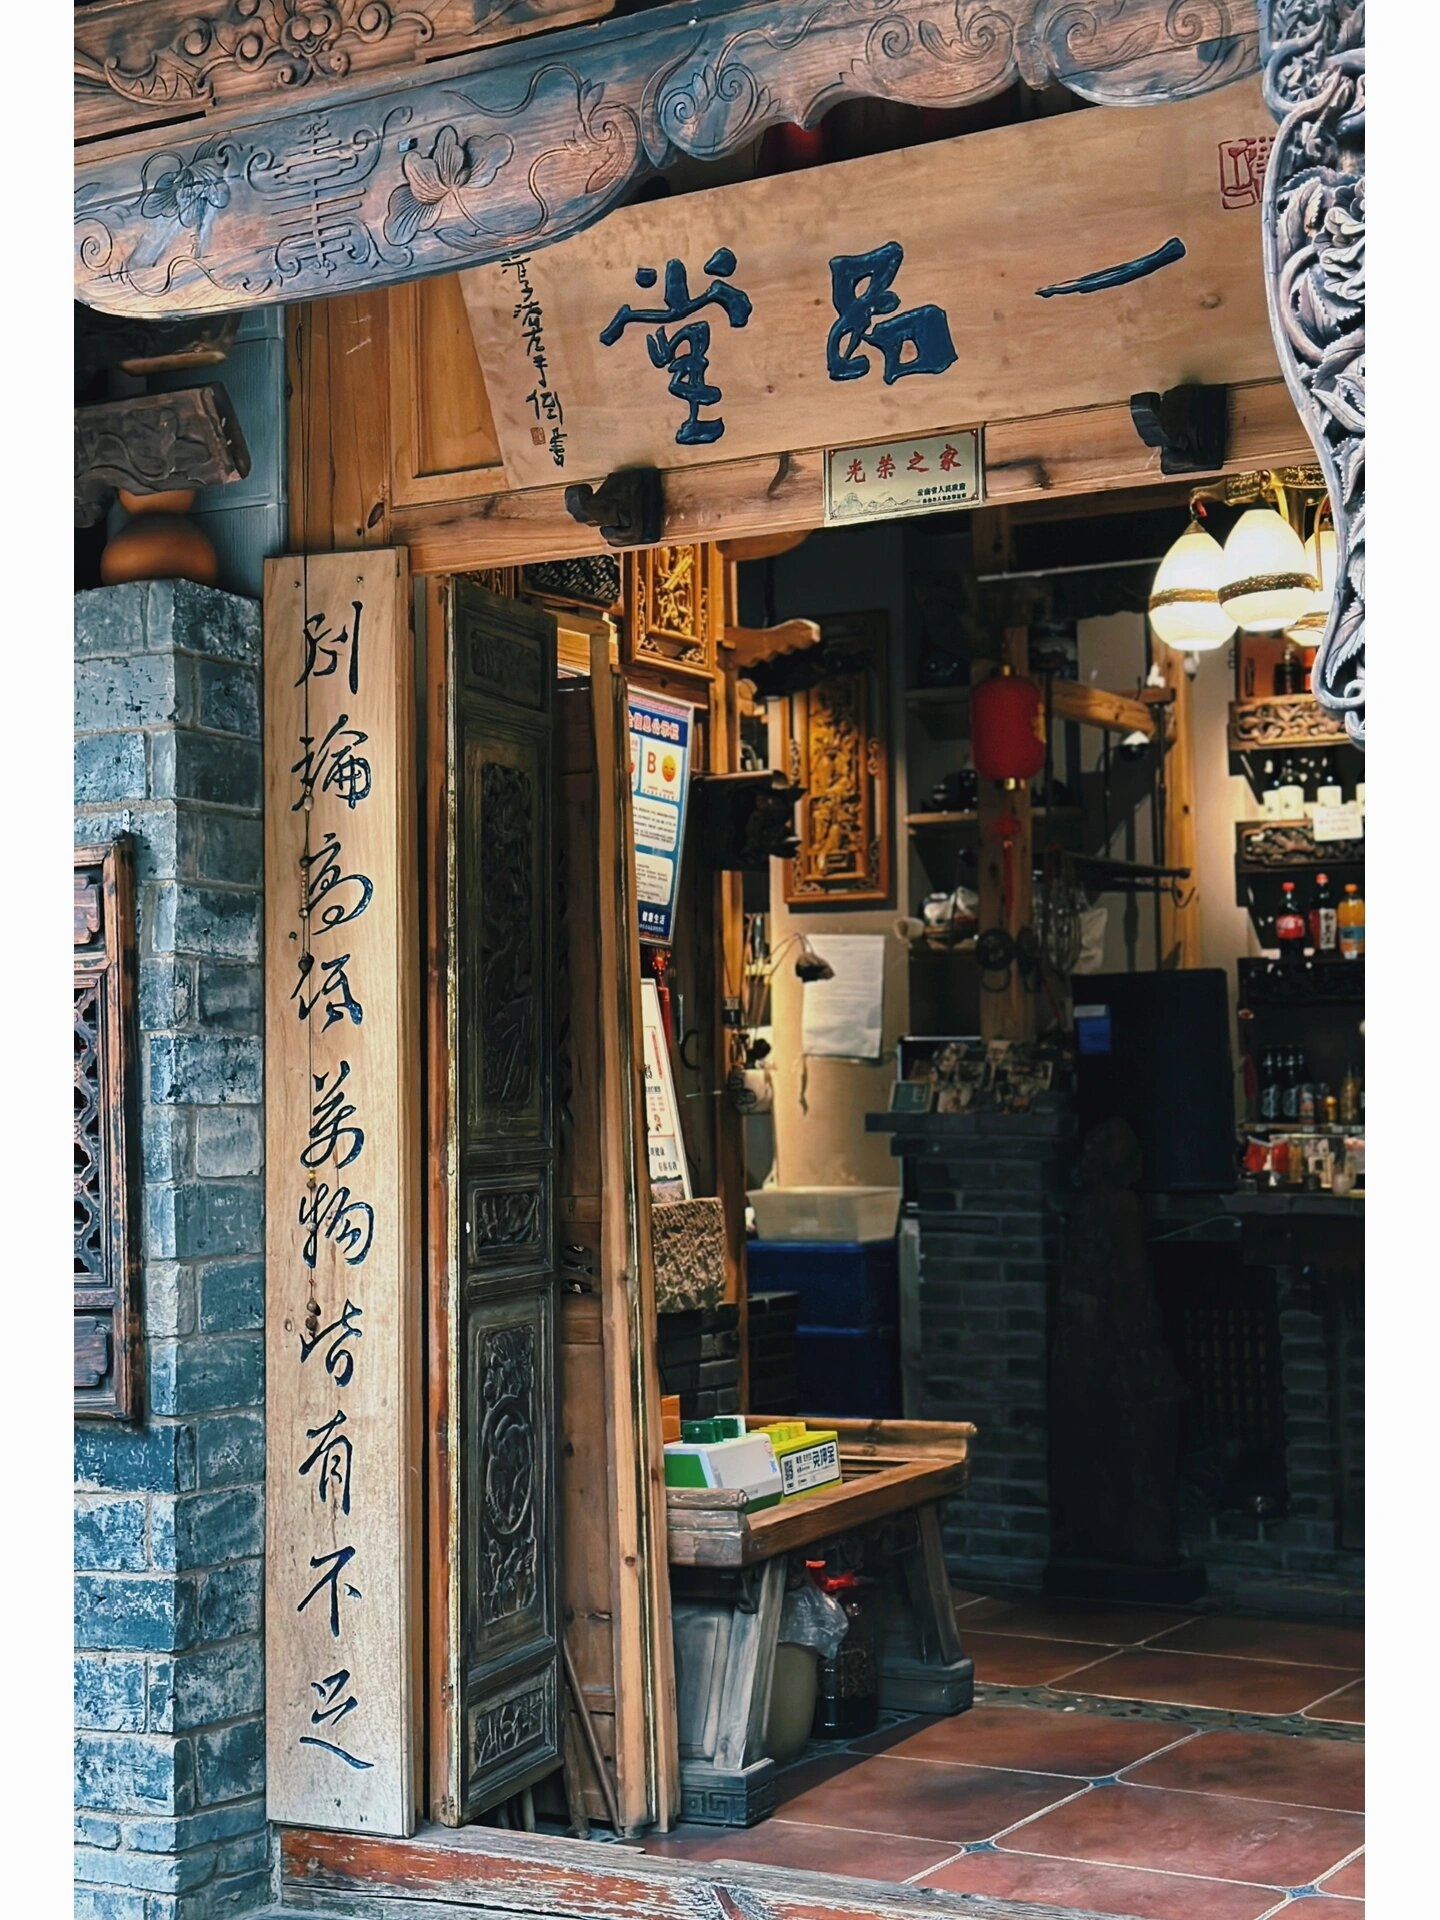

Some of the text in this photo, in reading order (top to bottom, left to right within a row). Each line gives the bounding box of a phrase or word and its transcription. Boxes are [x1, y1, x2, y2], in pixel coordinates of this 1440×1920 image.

[844, 443, 962, 484] 光荣之家
[647, 751, 657, 774] B
